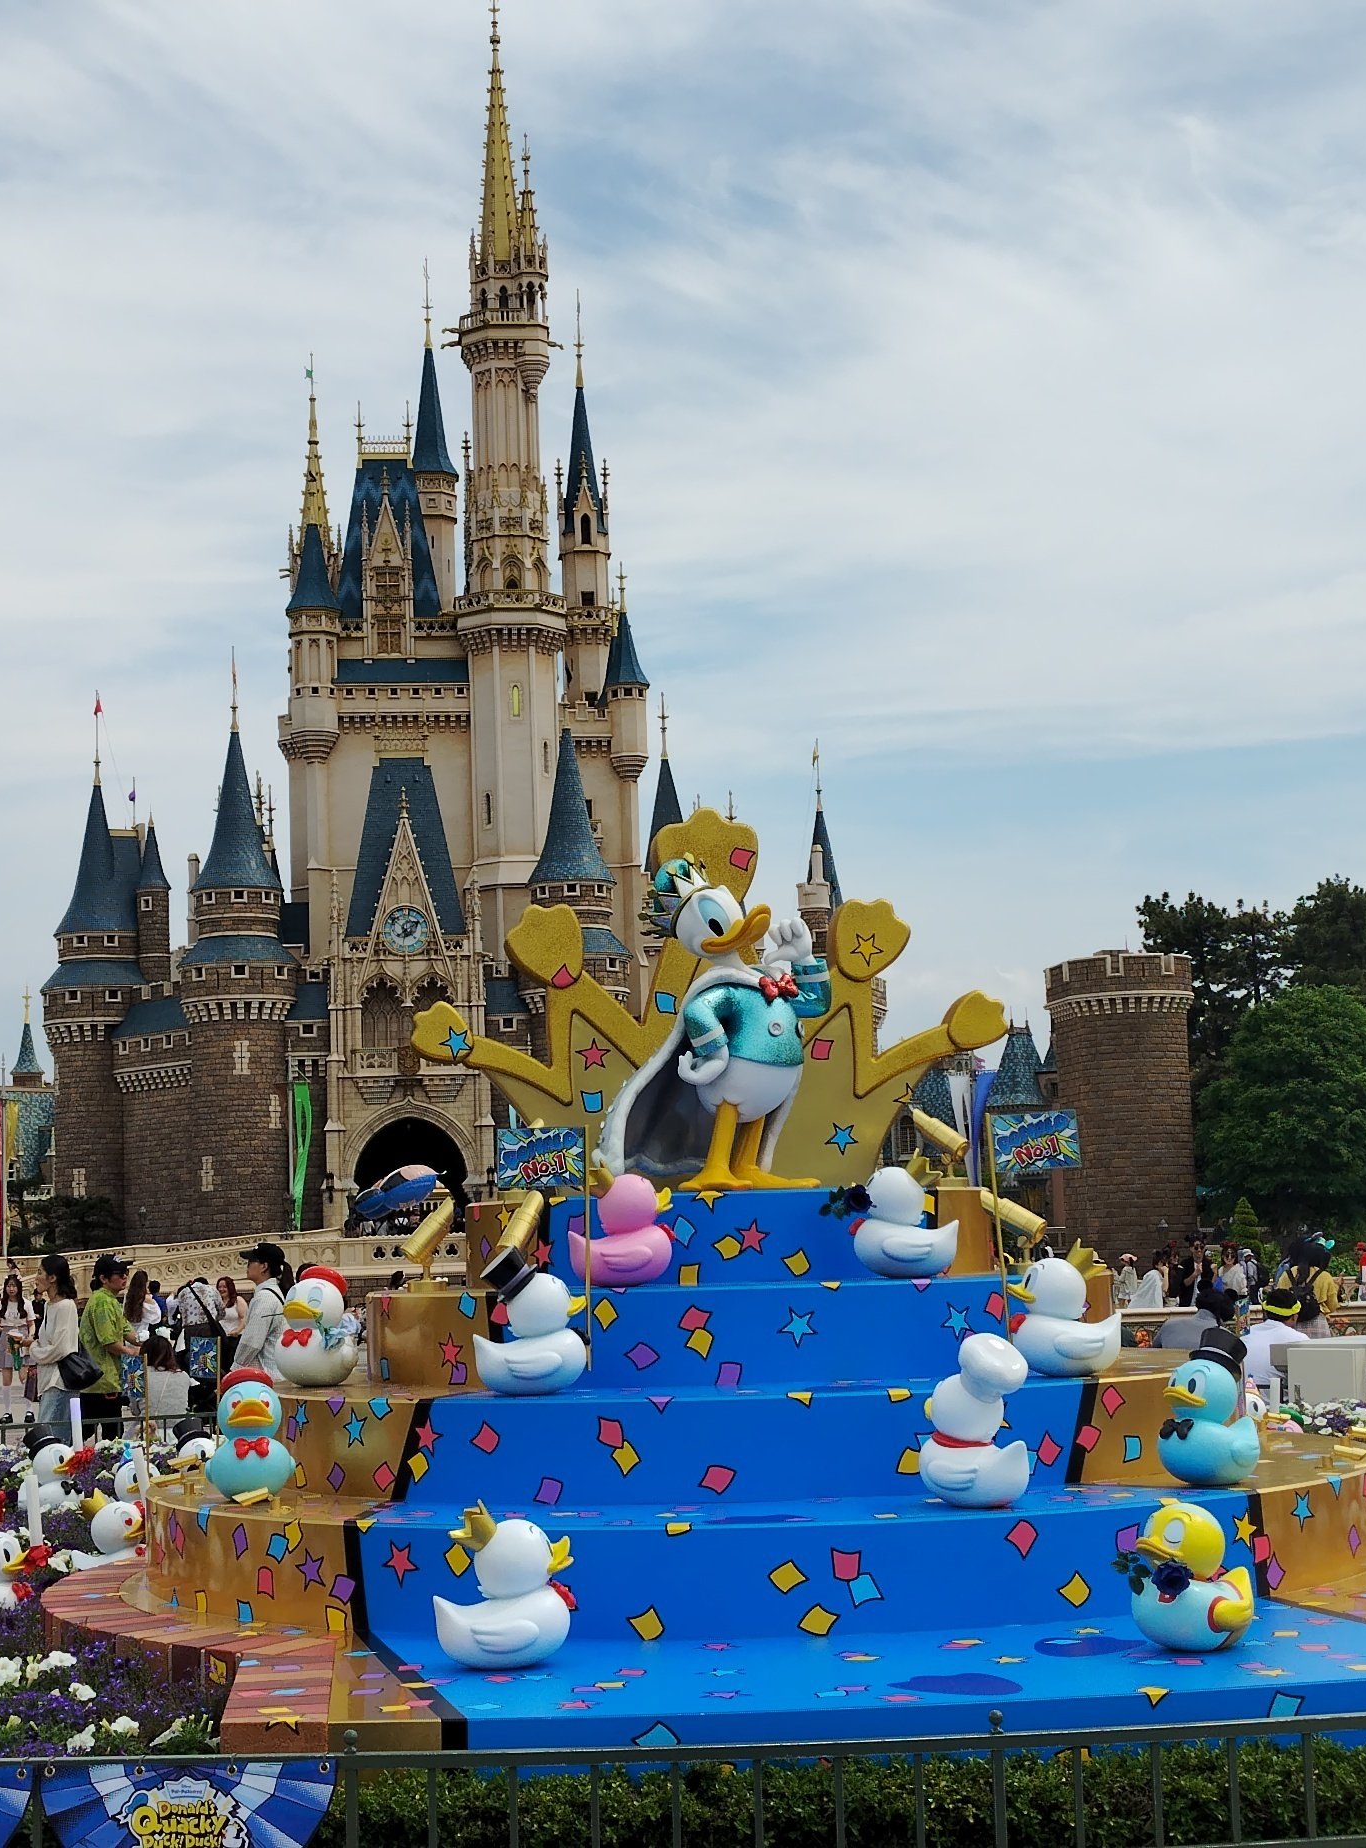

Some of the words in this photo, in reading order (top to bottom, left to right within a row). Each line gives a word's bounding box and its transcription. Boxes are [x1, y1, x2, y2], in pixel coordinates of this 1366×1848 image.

[1014, 1134, 1060, 1168] No.1
[520, 1151, 566, 1183] No.1
[131, 1805, 228, 1836] Quacky
[157, 1799, 215, 1818] Donald's
